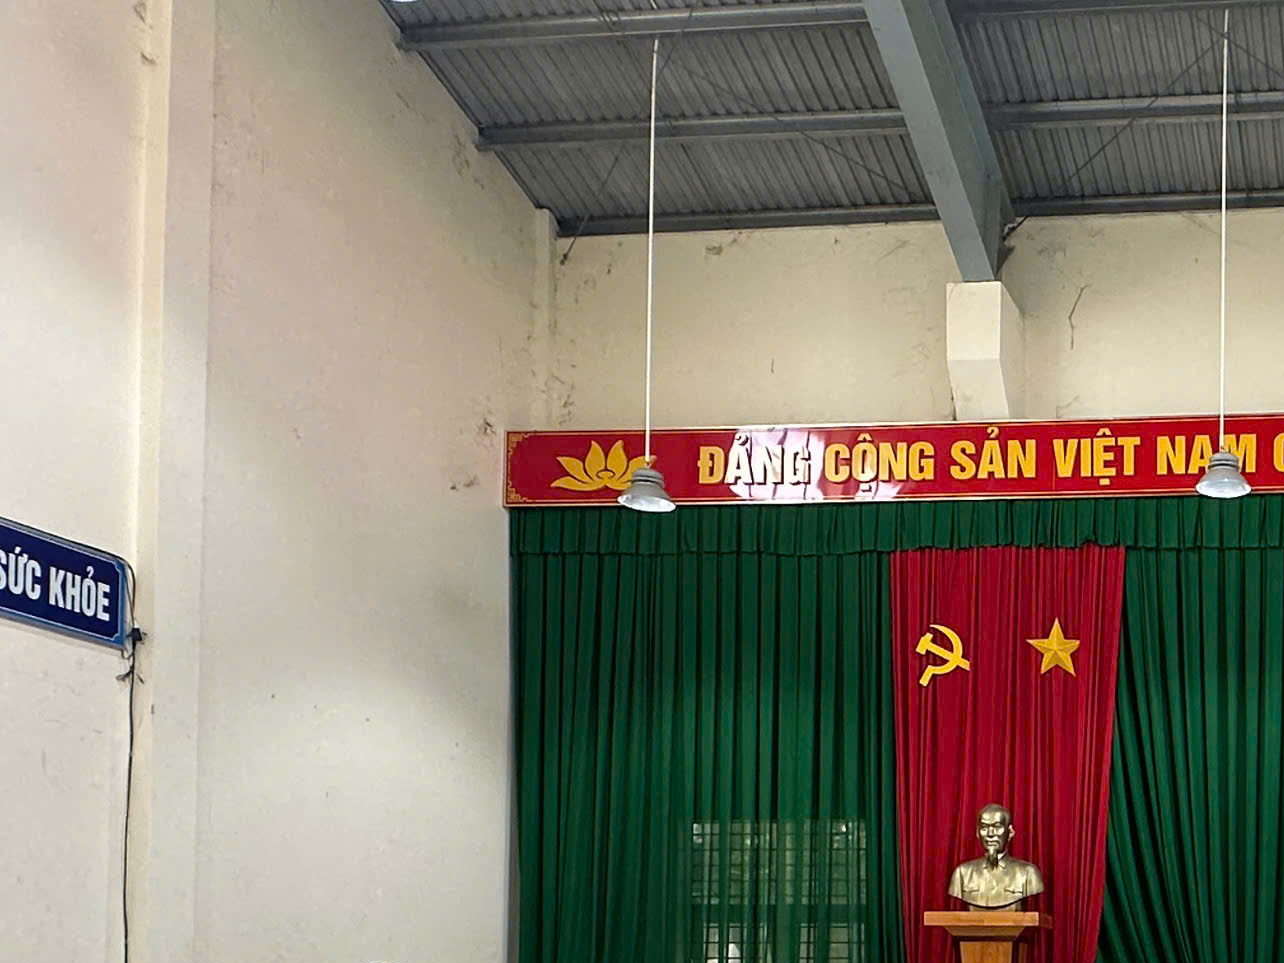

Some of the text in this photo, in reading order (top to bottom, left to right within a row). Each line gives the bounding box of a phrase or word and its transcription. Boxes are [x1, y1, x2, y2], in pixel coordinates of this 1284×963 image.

[697, 434, 812, 486] ĐẢNG
[824, 432, 936, 493] CỘNG
[949, 425, 1037, 480] SẢN
[1052, 427, 1142, 486] VIỆT
[1156, 433, 1257, 476] NAM
[48, 565, 111, 622] KHỎE
